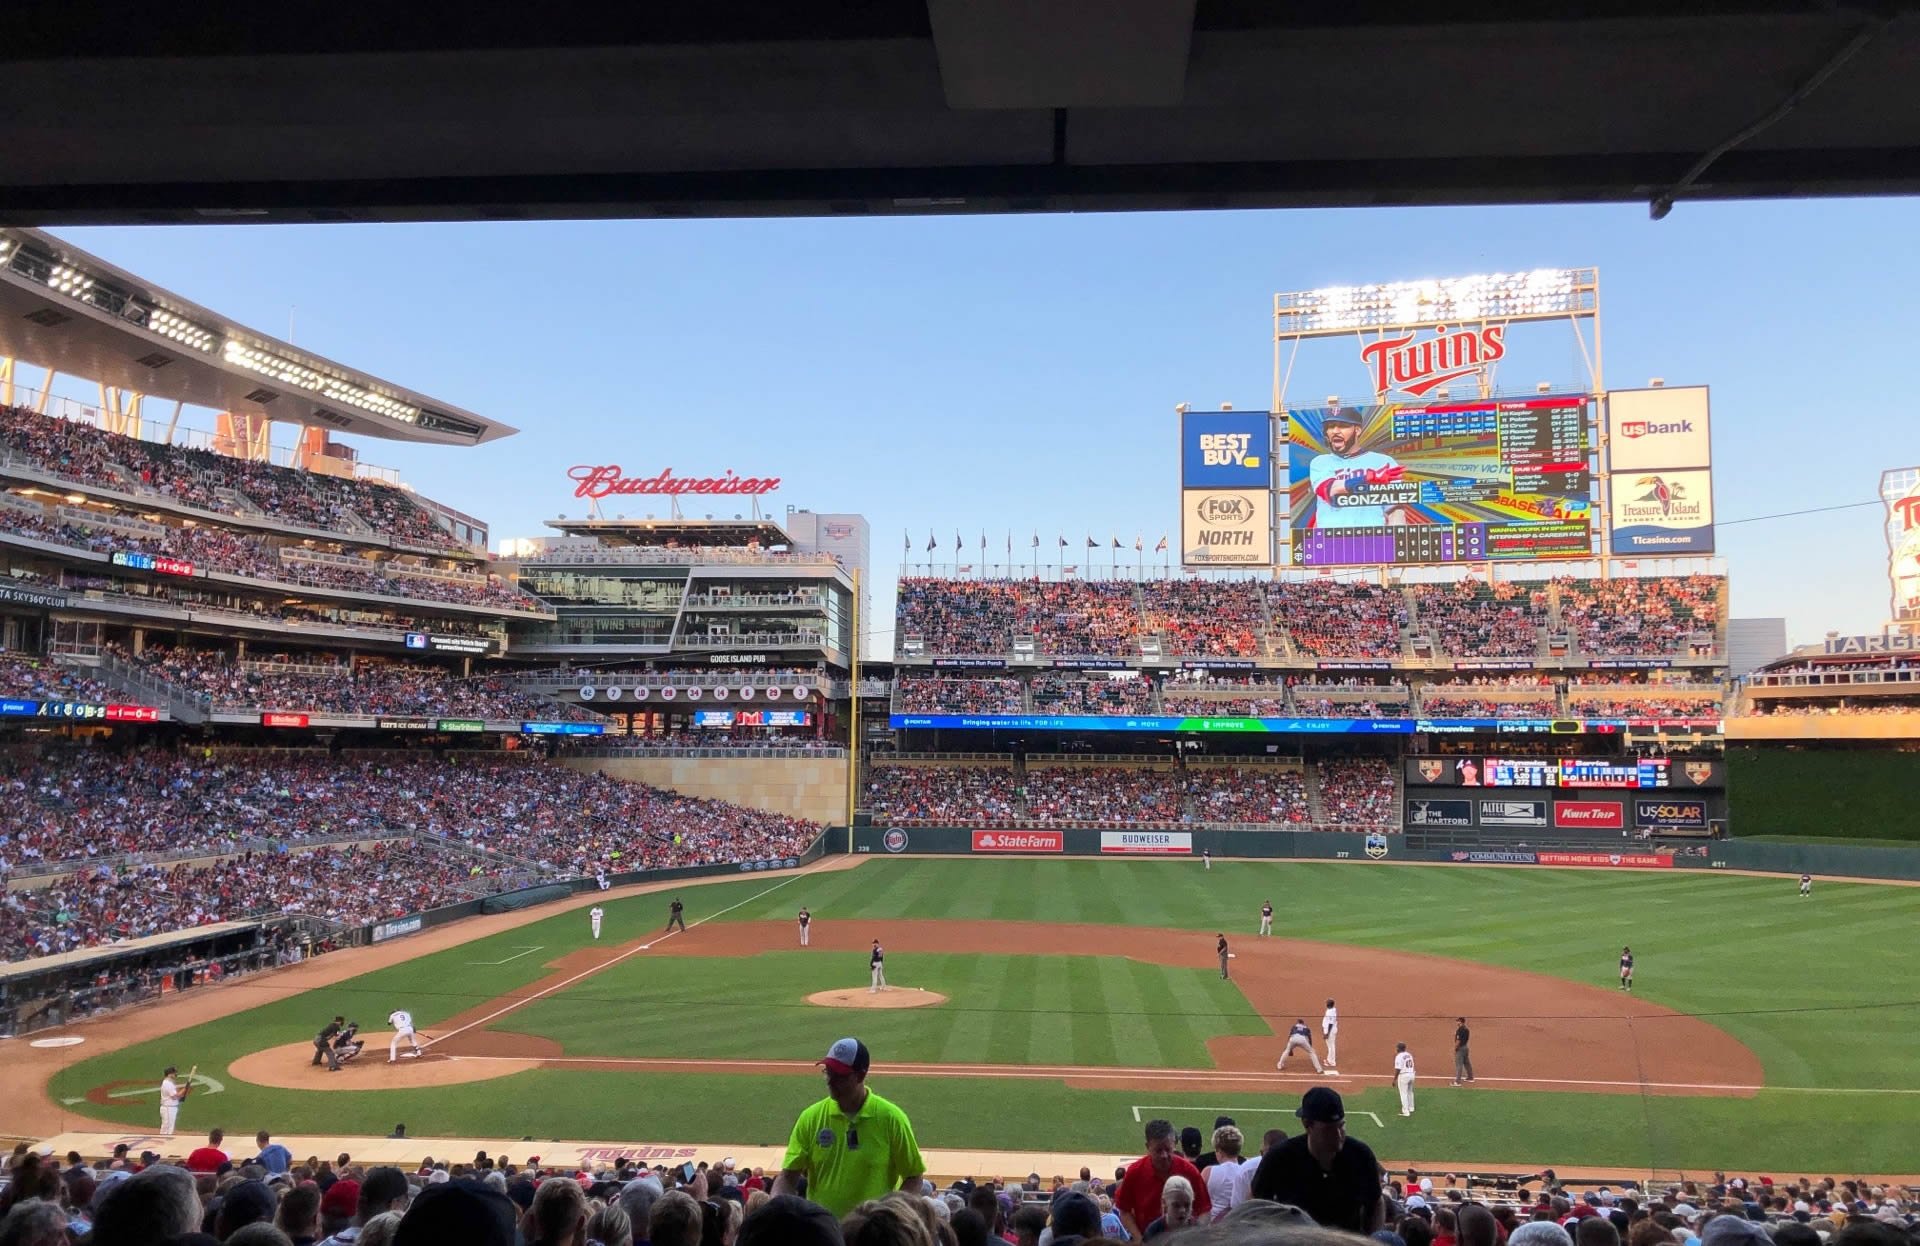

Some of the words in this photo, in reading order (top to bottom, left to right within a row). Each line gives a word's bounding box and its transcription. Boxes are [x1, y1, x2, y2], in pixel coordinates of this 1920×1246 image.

[1360, 325, 1505, 396] Twins
[1200, 434, 1251, 450] BEST
[1204, 450, 1247, 466] BUY
[568, 465, 780, 498] Budweiser
[1369, 483, 1418, 491] MARWIN
[1336, 493, 1418, 506] GONZALEZ
[1209, 500, 1243, 514] FOX
[1622, 504, 1661, 516] Treasure
[1671, 501, 1700, 515] Island
[1198, 530, 1254, 545] NORTH
[1195, 554, 1259, 562] FOXSPORTSNORTH.COM
[46, 597, 64, 608] CLUB
[596, 619, 624, 630] TWINS
[710, 655, 730, 663] GOOSE
[730, 655, 752, 663] ISLAND
[76, 706, 84, 716] 0
[136, 709, 142, 718] 0
[1562, 808, 1591, 819] KWIK
[1591, 808, 1616, 819] TRIP
[1122, 834, 1170, 844] BUDWEISER
[1470, 852, 1513, 862] COMMUNITY
[1514, 854, 1535, 862] FUND
[1540, 854, 1568, 863] GETTING
[1570, 855, 1590, 863] MORE
[1592, 856, 1610, 864] KIDS
[1622, 856, 1636, 864] THE
[1637, 856, 1660, 864] GAME.
[1712, 860, 1726, 868] 411
[576, 1147, 698, 1162] Twins
